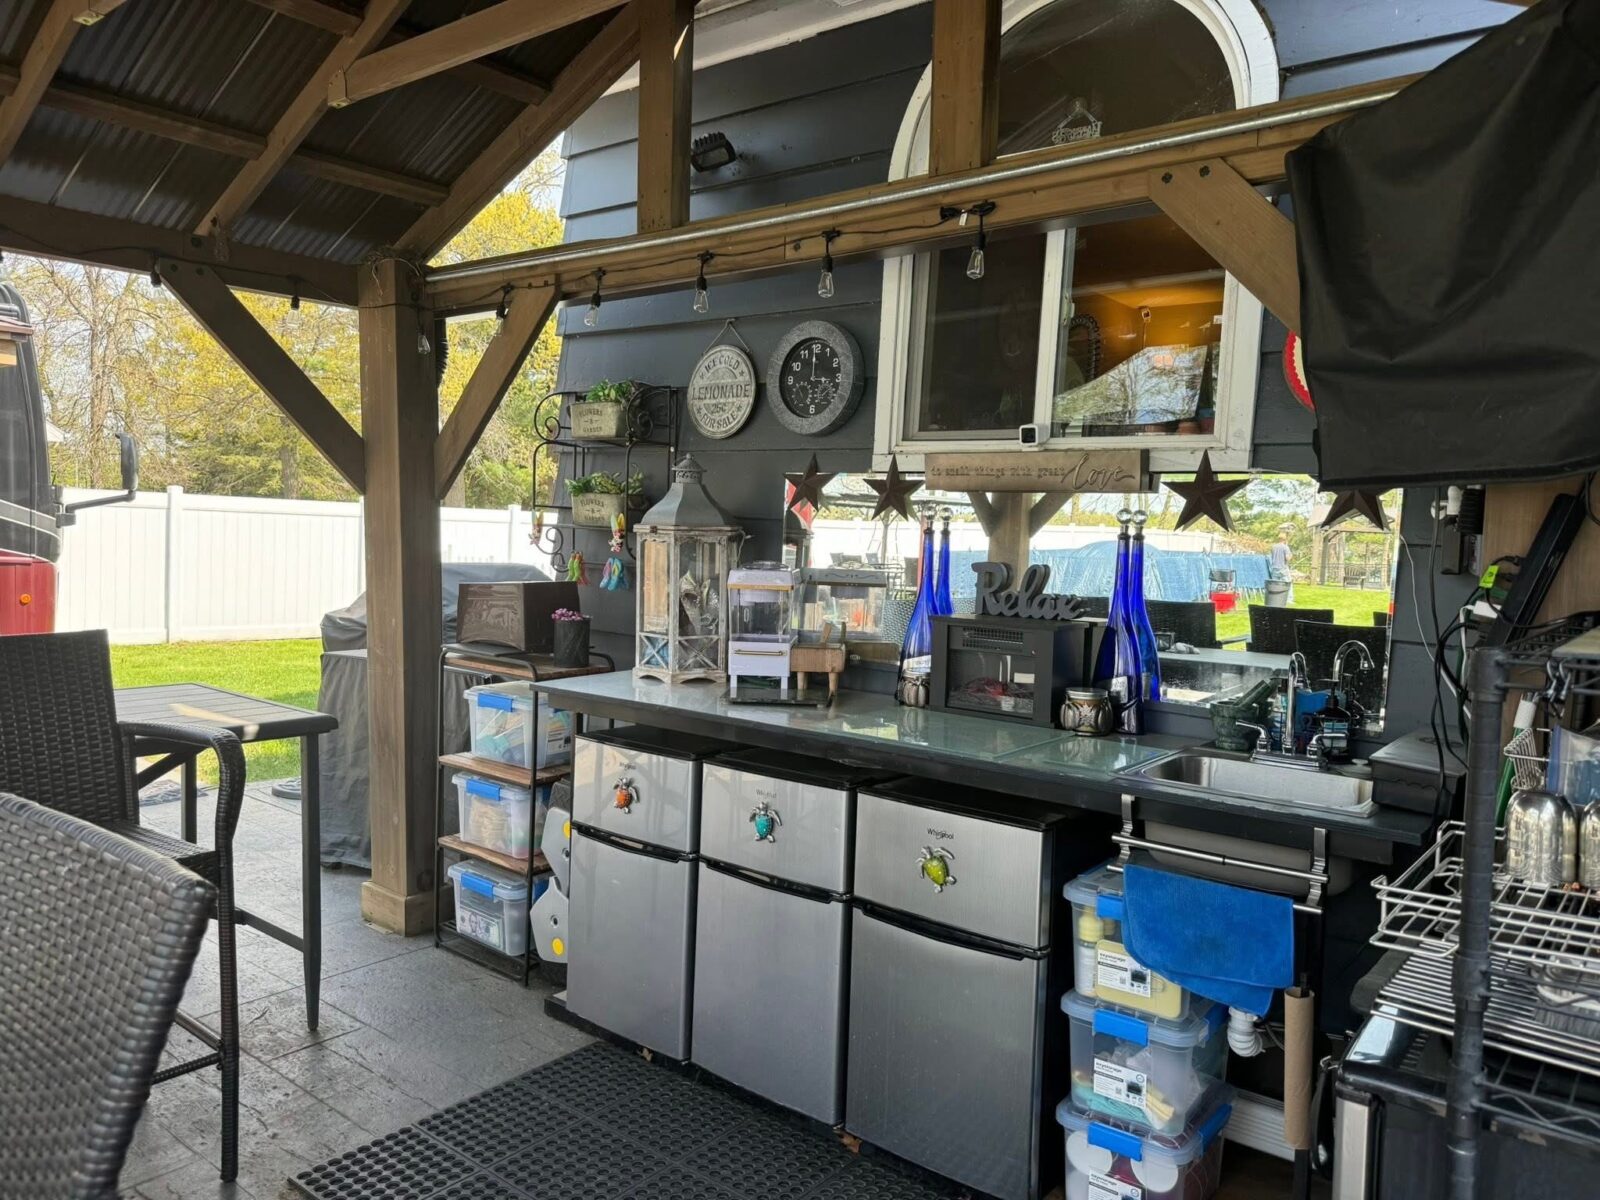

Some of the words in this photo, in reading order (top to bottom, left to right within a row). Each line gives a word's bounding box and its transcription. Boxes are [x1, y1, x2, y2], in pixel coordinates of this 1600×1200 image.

[812, 344, 821, 353] 12
[825, 348, 830, 357] 1
[800, 350, 809, 359] 11
[704, 359, 716, 372] ICE
[718, 355, 740, 370] COLD
[792, 362, 801, 371] 10
[832, 357, 839, 367] 2
[787, 376, 794, 385] 9
[835, 373, 842, 383] 3
[692, 383, 751, 400] LEMONADE
[809, 405, 816, 414] 6
[700, 413, 715, 429] FOR
[717, 411, 737, 429] SALE
[971, 561, 1083, 620] Relax
[927, 827, 954, 840] Whirlpool
